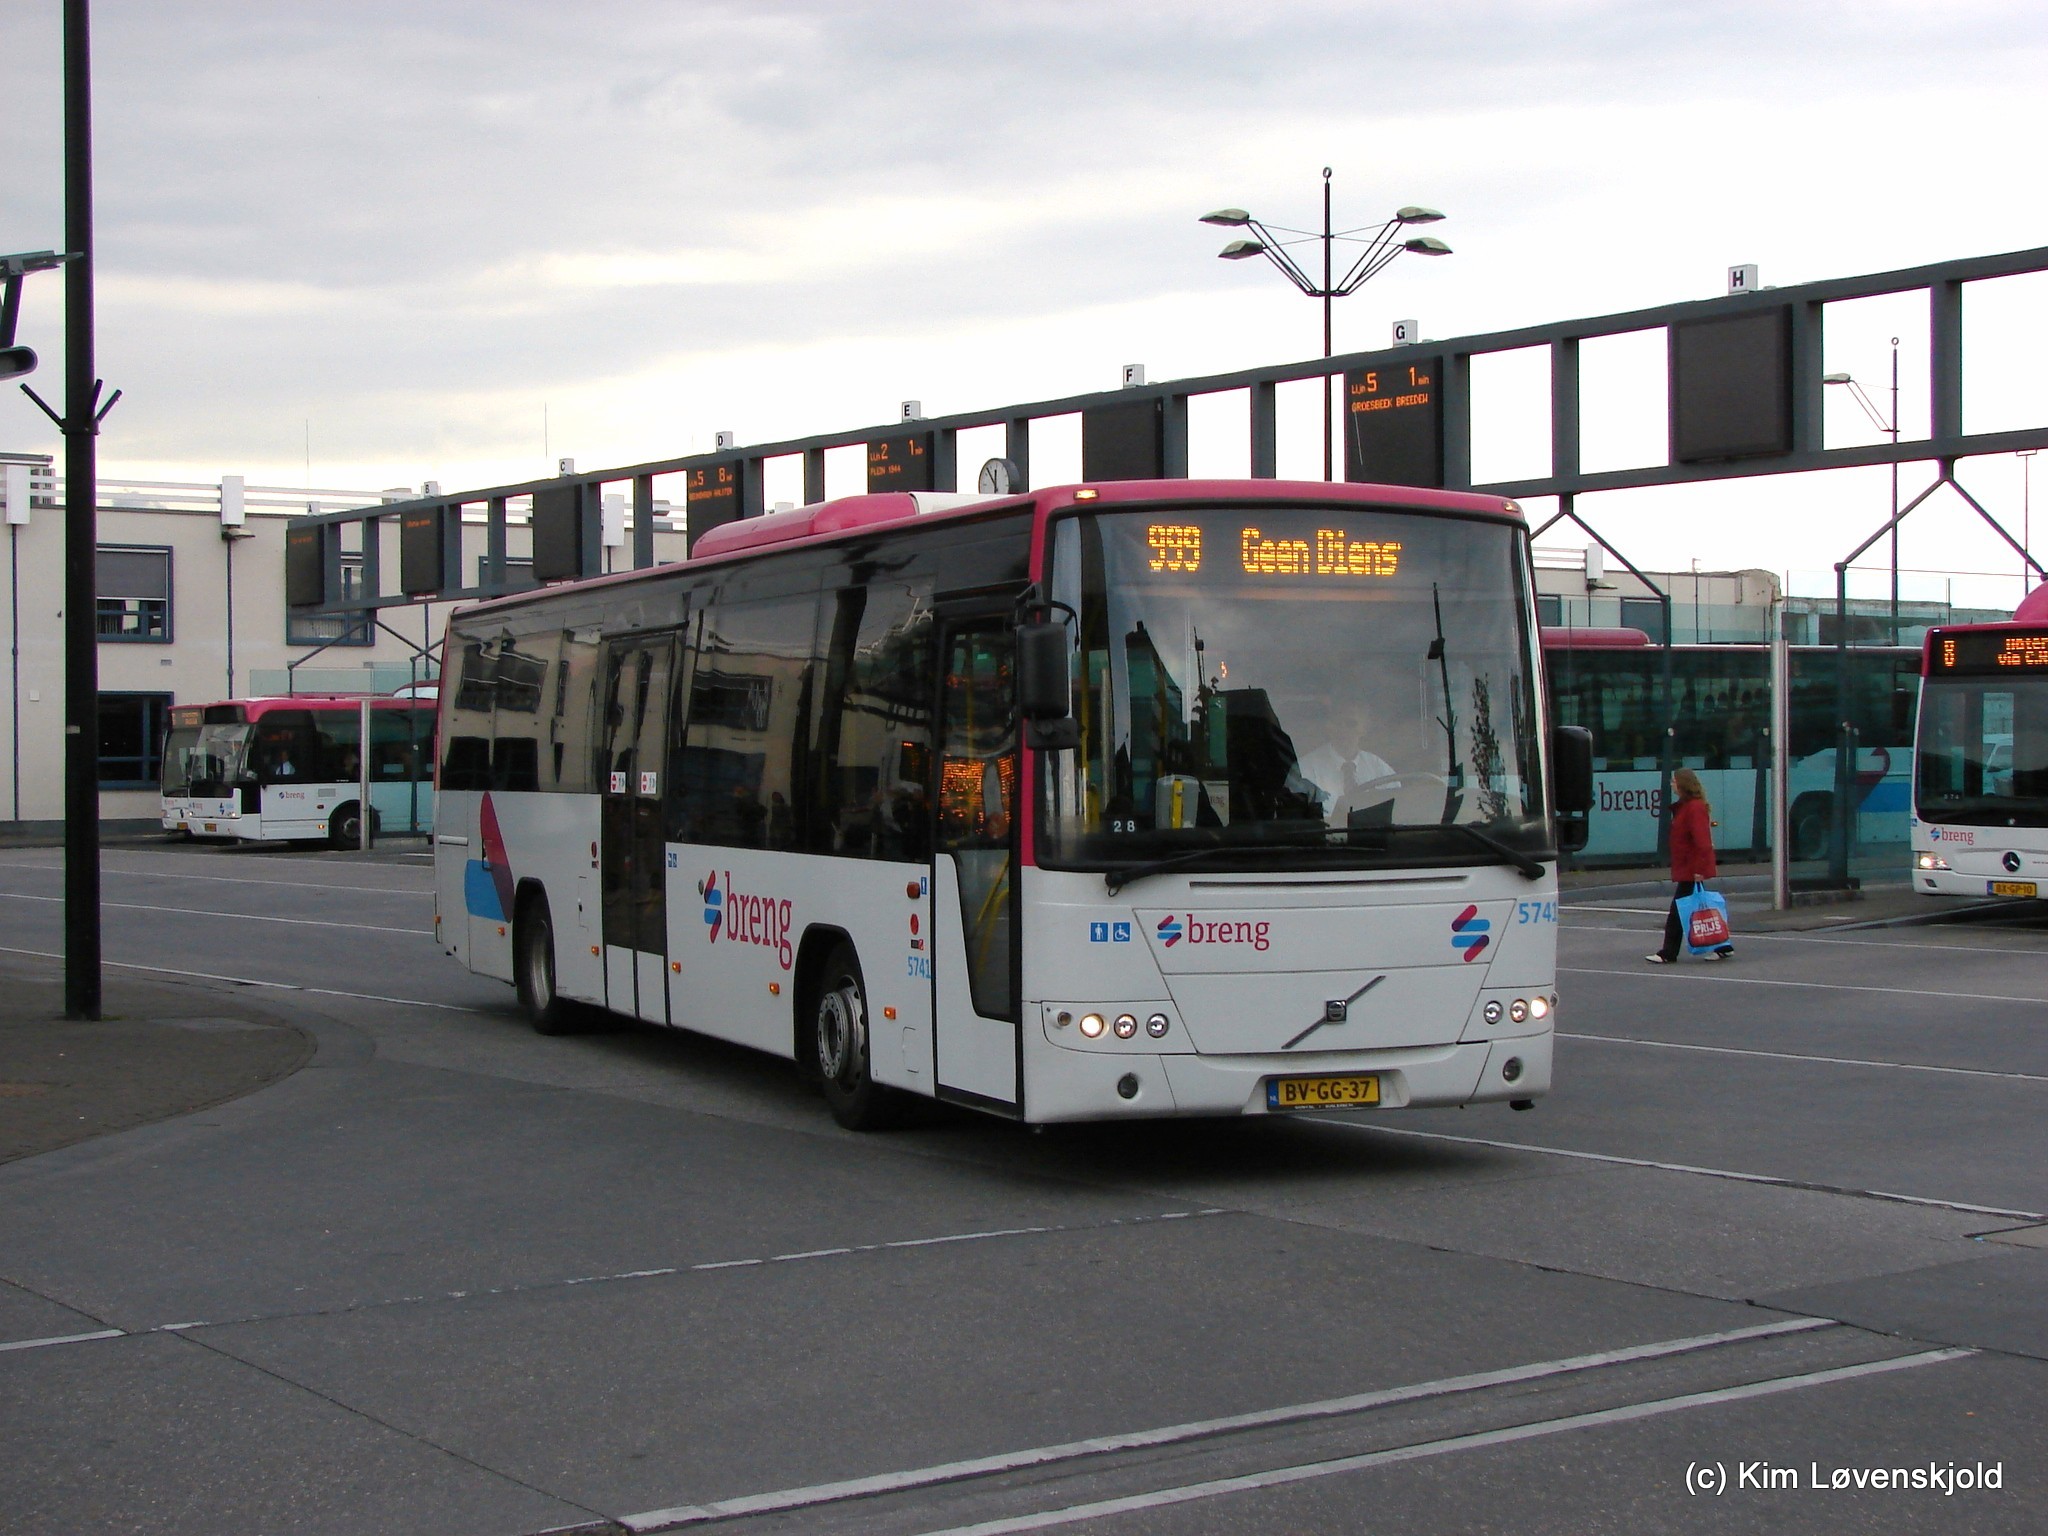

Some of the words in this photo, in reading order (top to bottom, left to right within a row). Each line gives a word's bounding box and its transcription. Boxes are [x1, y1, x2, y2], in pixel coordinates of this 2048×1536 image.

[1732, 270, 1744, 287] H
[1395, 325, 1406, 340] G
[1126, 368, 1133, 382] F
[1366, 372, 1377, 392] 5
[1409, 366, 1416, 387] 1
[904, 404, 910, 416] E
[1351, 398, 1393, 412] GROESBEEK
[717, 435, 724, 446] D
[880, 443, 888, 460] 2
[909, 439, 914, 455] 1
[560, 461, 566, 472] C
[697, 470, 704, 486] 5
[718, 467, 726, 482] 8
[1148, 525, 1201, 572] 999
[1242, 527, 1310, 574] Geen
[1598, 781, 1663, 818] breng
[1941, 827, 1975, 846] breng
[724, 870, 793, 971] breng
[1518, 901, 1558, 924] 5741
[1186, 913, 1271, 951] breng
[1693, 920, 1722, 934] PRIJS
[908, 956, 932, 979] 5741
[1285, 1081, 1371, 1102] BV-GG-37
